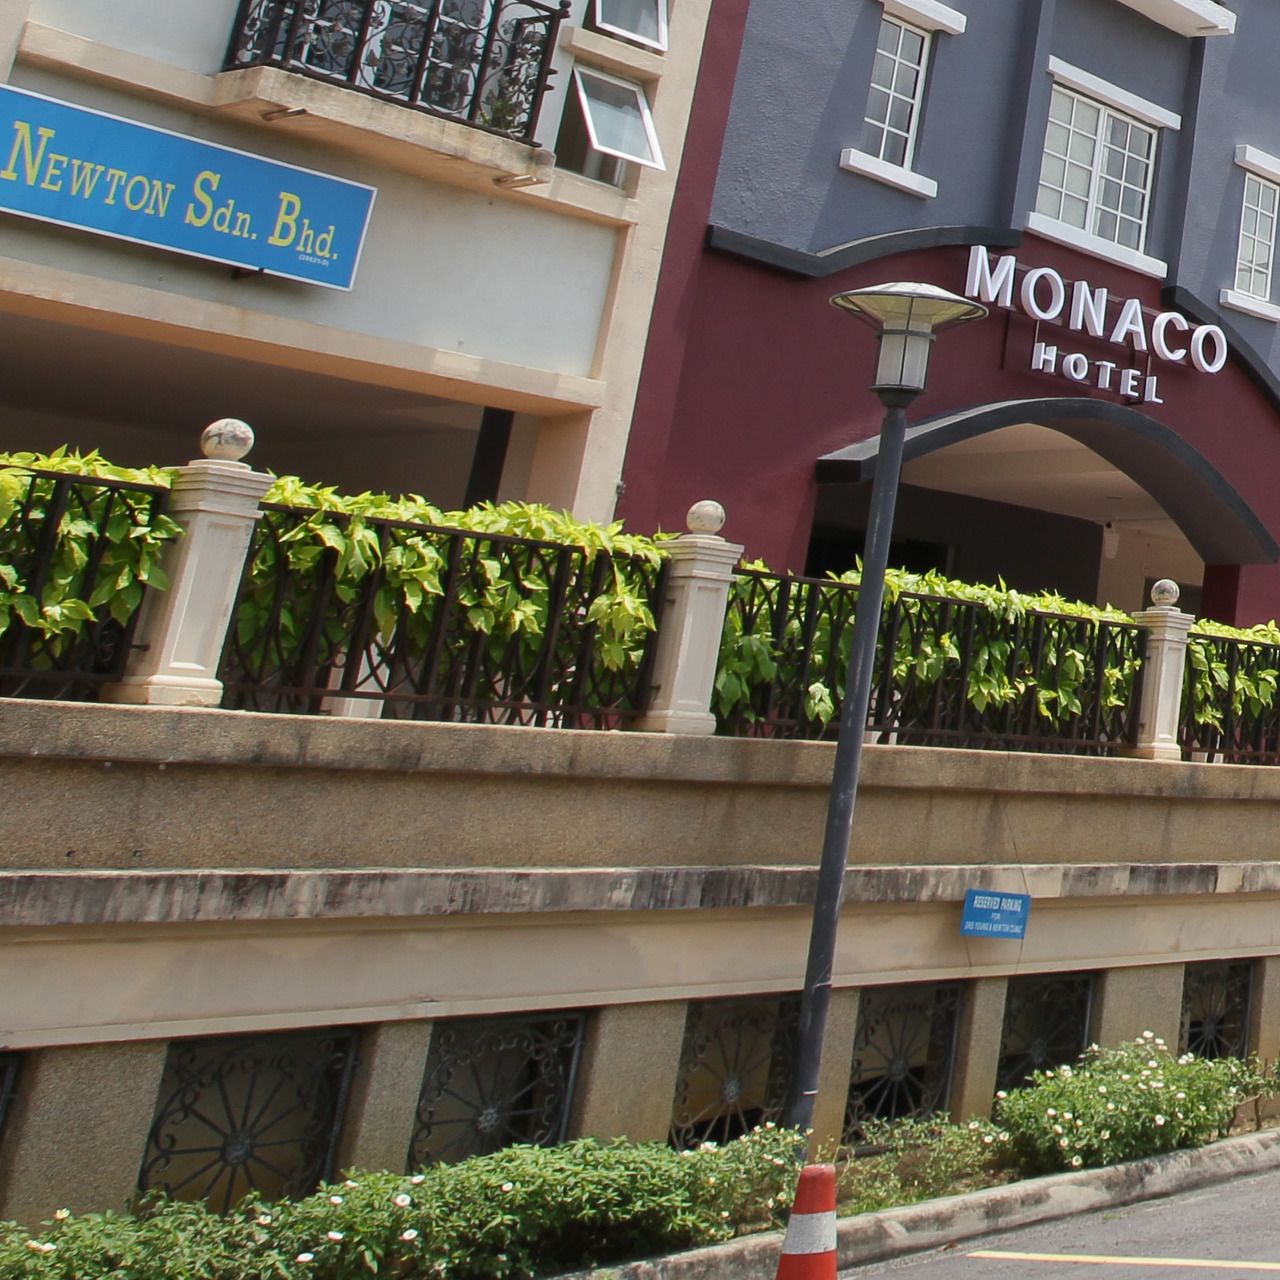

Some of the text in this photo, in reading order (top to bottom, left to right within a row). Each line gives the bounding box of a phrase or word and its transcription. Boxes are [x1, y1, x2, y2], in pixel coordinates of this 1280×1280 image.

[185, 170, 258, 241] Sdn.
[267, 191, 339, 260] Bhd.
[965, 245, 1228, 374] MONACO
[1031, 342, 1164, 404] HOTEL
[973, 895, 1022, 912] RESERVED PARKING
